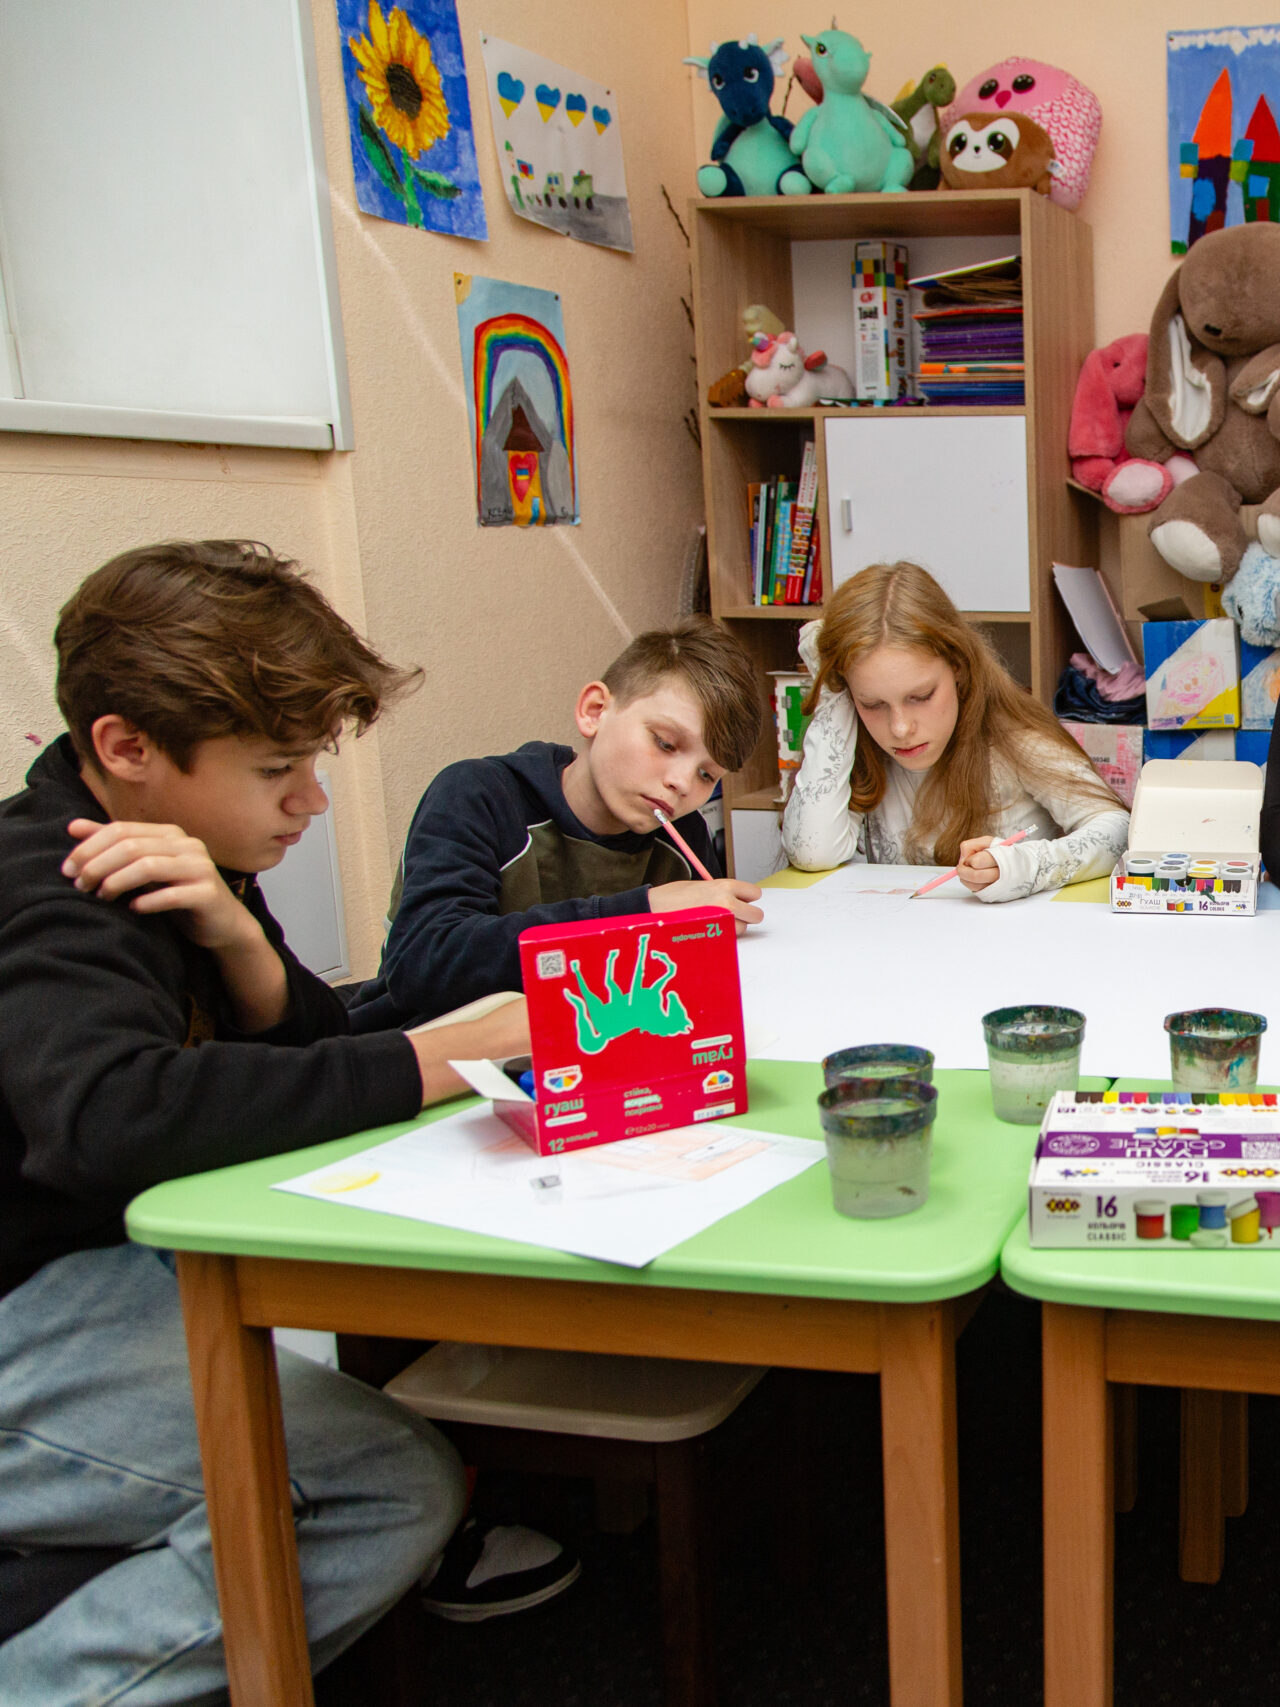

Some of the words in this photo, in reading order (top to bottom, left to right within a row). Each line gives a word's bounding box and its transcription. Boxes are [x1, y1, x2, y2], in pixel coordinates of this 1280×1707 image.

[1198, 900, 1209, 911] 16
[706, 923, 722, 938] 12
[692, 1045, 733, 1066] гуаш
[544, 1098, 584, 1117] гуаш
[548, 1137, 565, 1153] 12
[1109, 1138, 1227, 1150] GOUACHE
[1125, 1148, 1209, 1159] ГУАШ
[1184, 1171, 1210, 1183] 16
[1096, 1195, 1118, 1219] 16
